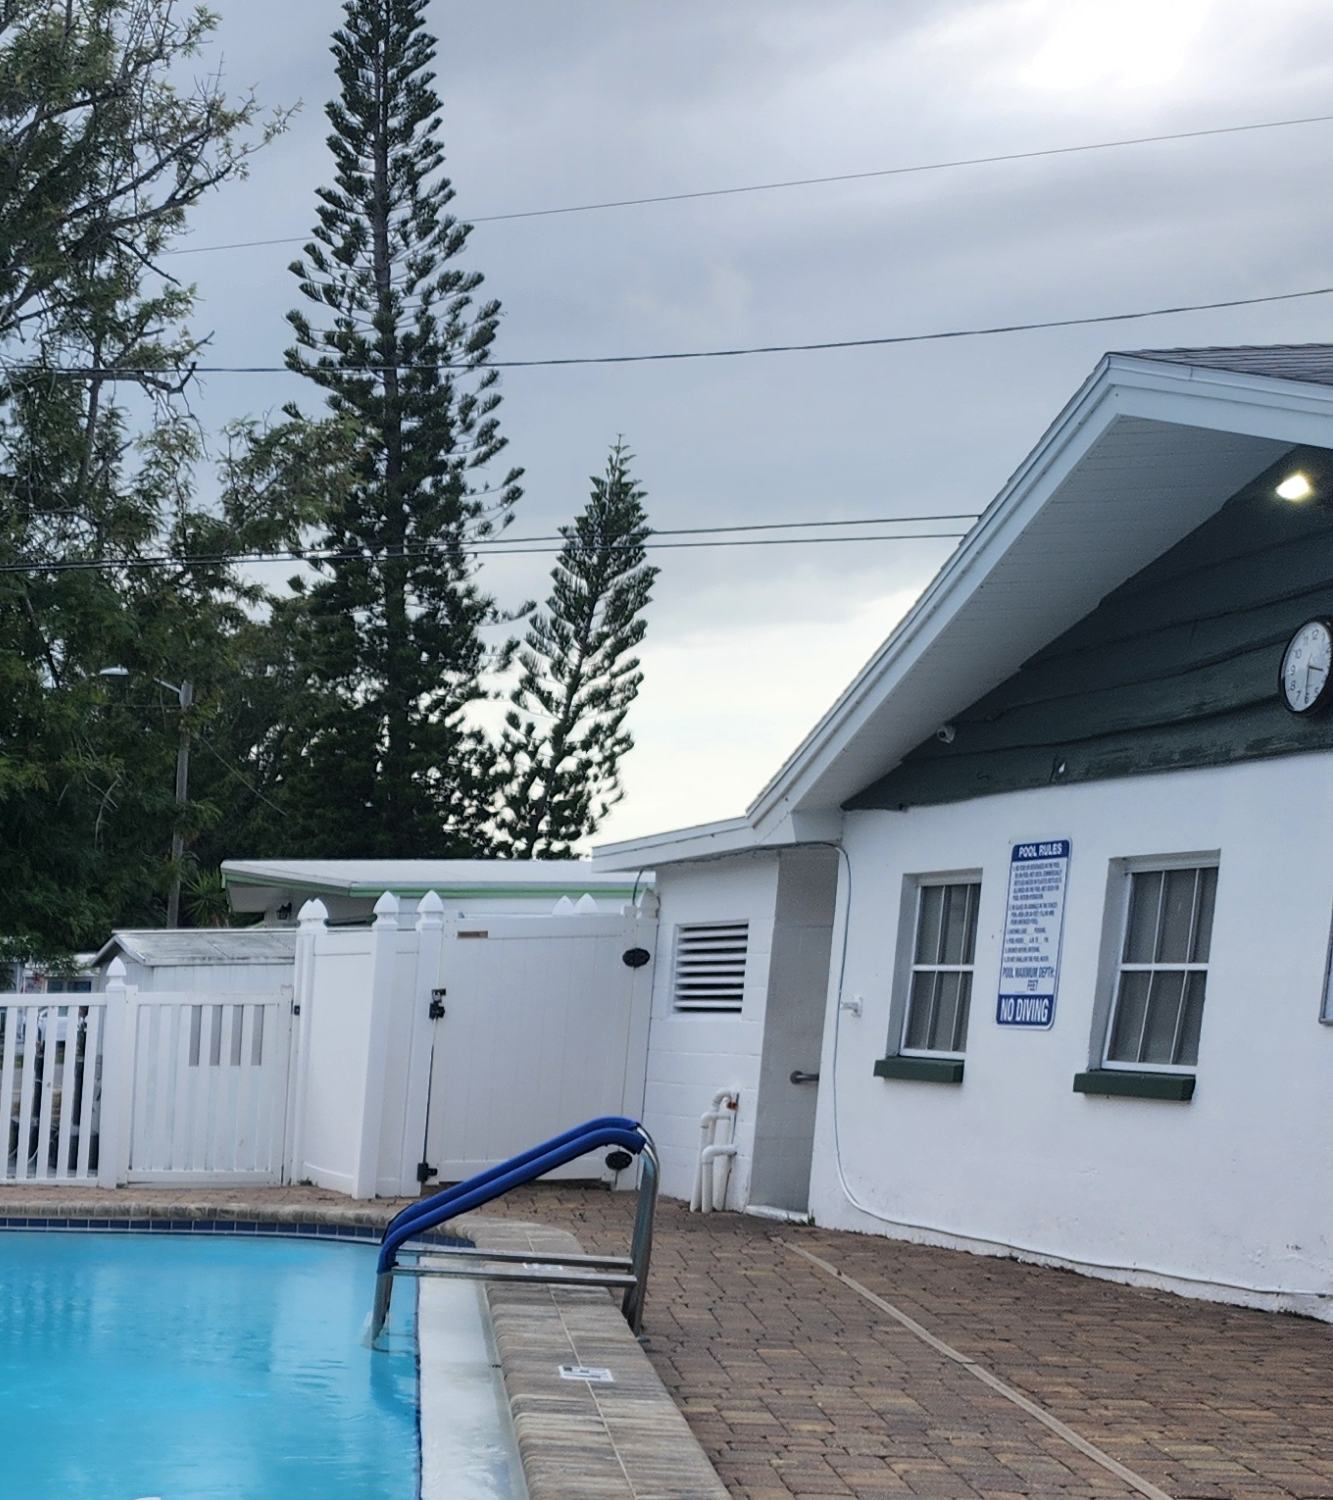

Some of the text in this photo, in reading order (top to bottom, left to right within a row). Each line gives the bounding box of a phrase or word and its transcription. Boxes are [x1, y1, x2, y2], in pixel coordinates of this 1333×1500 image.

[1018, 842, 1063, 858] POOL RULES
[1027, 979, 1039, 991] FEET
[1000, 998, 1050, 1022] NO DIVING
